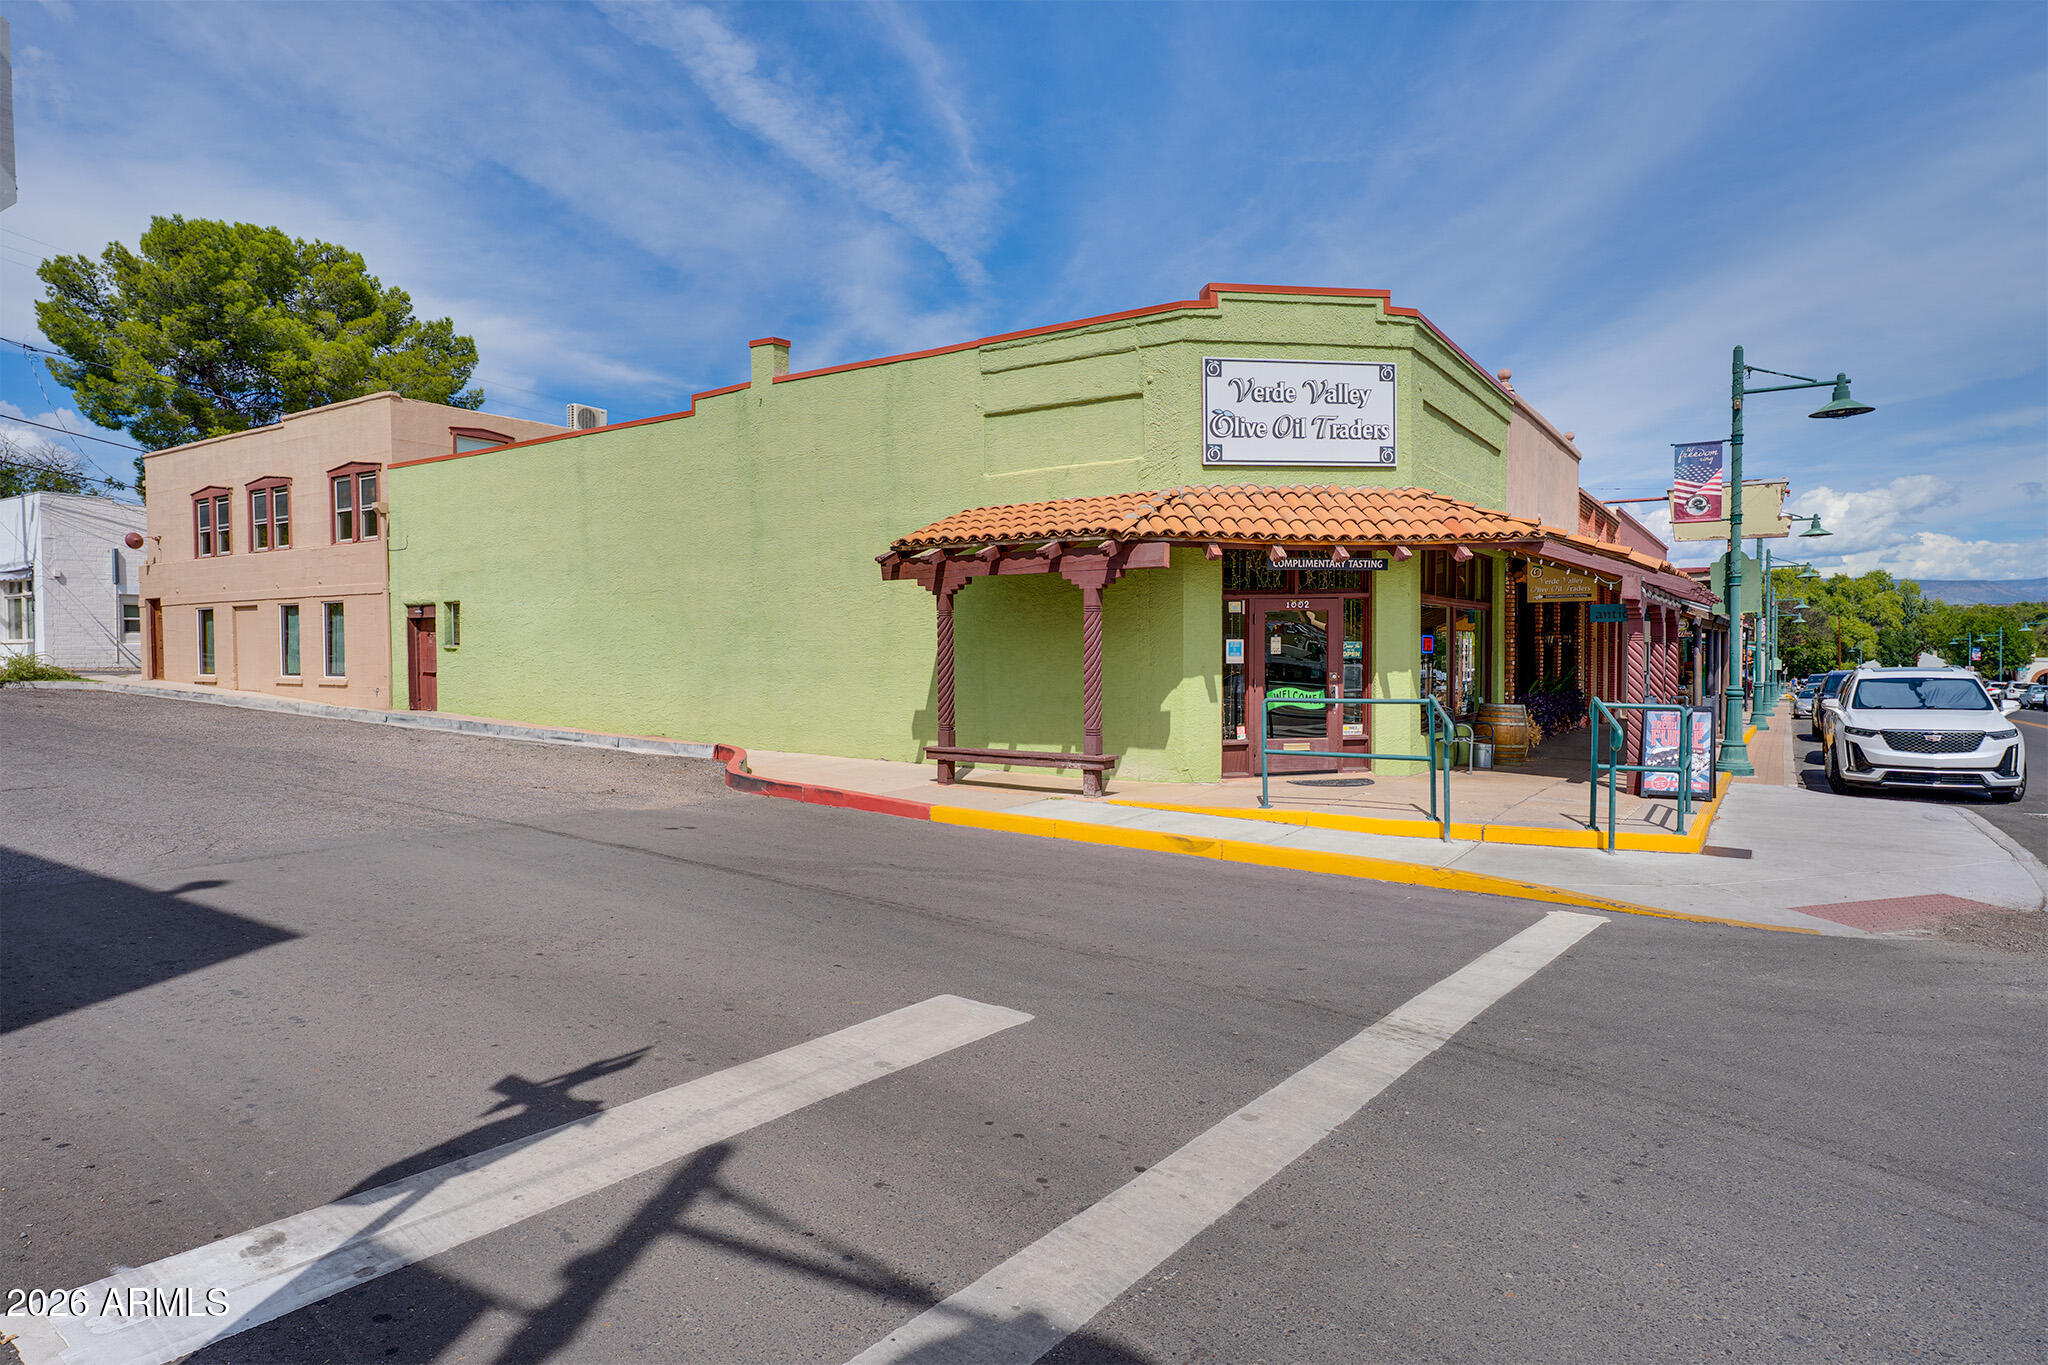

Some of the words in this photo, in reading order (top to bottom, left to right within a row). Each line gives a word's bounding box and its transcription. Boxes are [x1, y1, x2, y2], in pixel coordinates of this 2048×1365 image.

[1228, 377, 1297, 403] Verde
[1302, 379, 1372, 408] Valley
[1209, 410, 1268, 438] Olive
[1272, 414, 1306, 439] Oil
[1311, 415, 1390, 440] Traders
[1272, 559, 1346, 568] COMPLIMENTARY
[1348, 560, 1383, 568] TASTING
[1286, 600, 1310, 609] 1002
